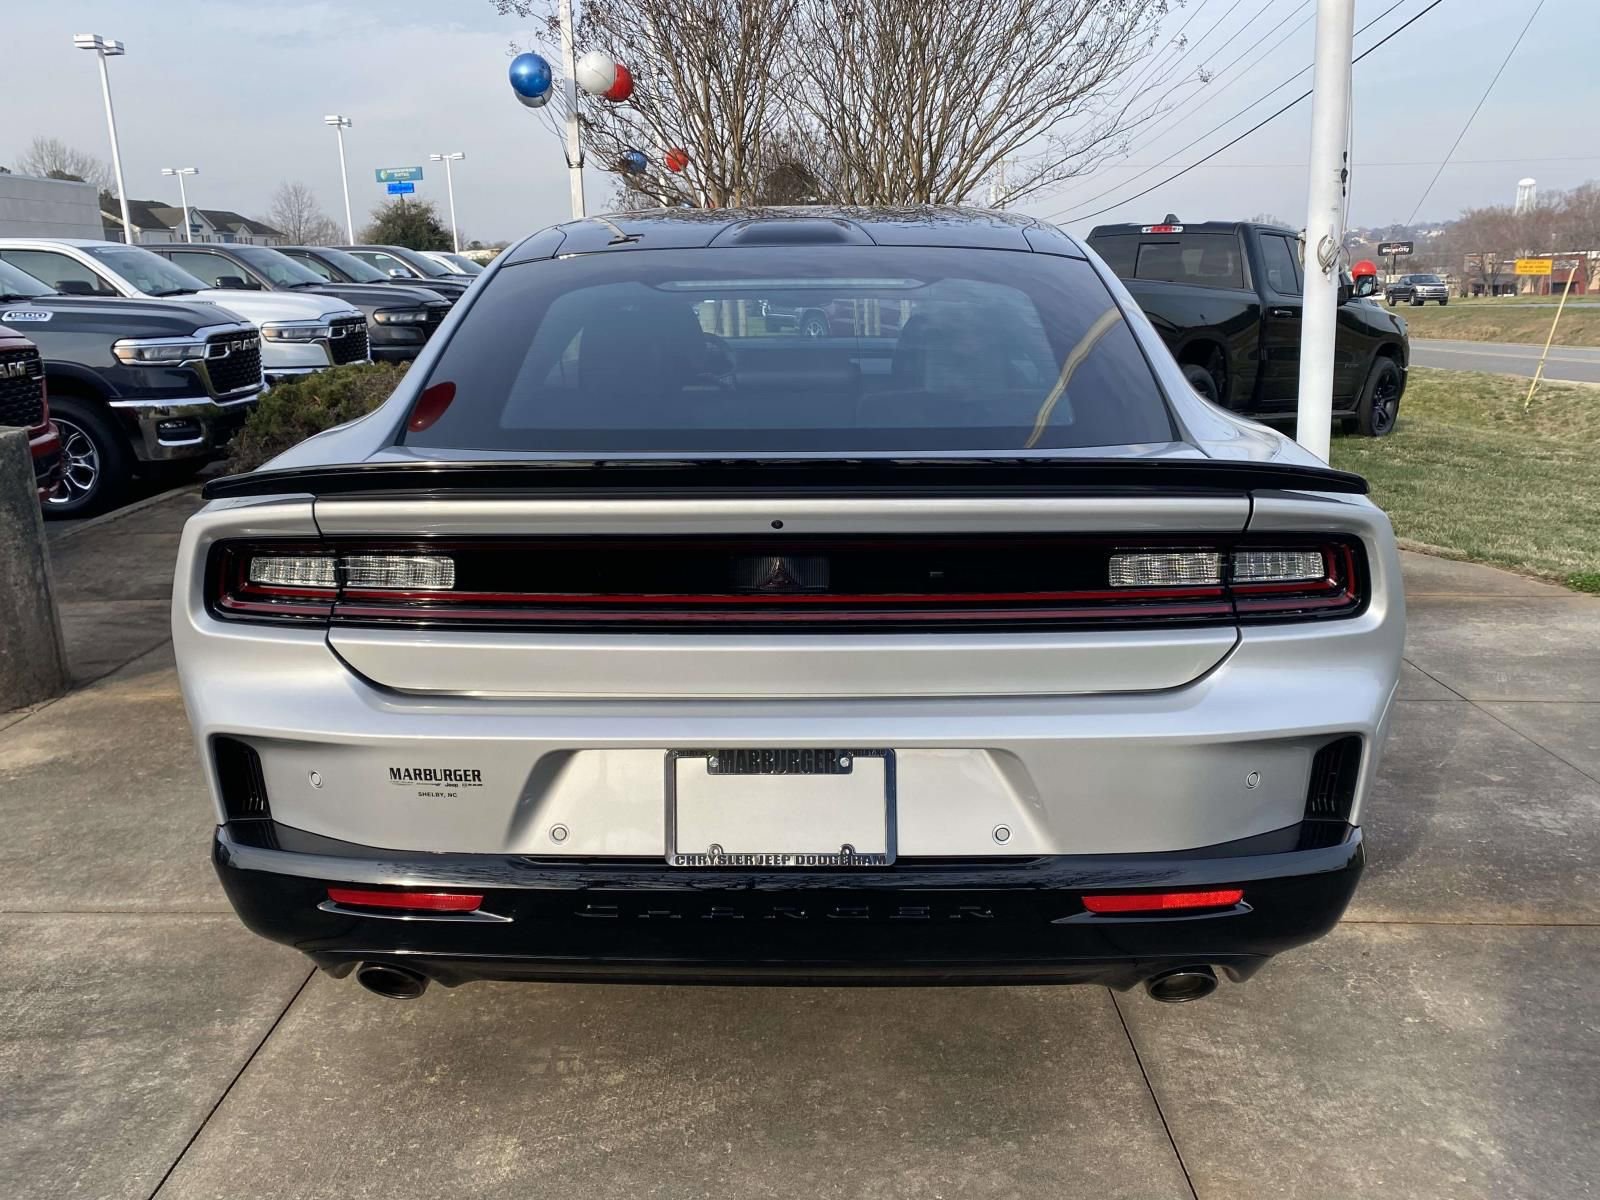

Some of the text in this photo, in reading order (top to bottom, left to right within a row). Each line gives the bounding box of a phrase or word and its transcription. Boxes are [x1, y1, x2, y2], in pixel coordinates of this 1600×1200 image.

[717, 748, 839, 774] MARBURGER
[389, 768, 482, 782] MARBURGER
[418, 791, 446, 799] SHELBY,
[674, 854, 888, 866] CHRYSLER JEEP DODGE RAM
